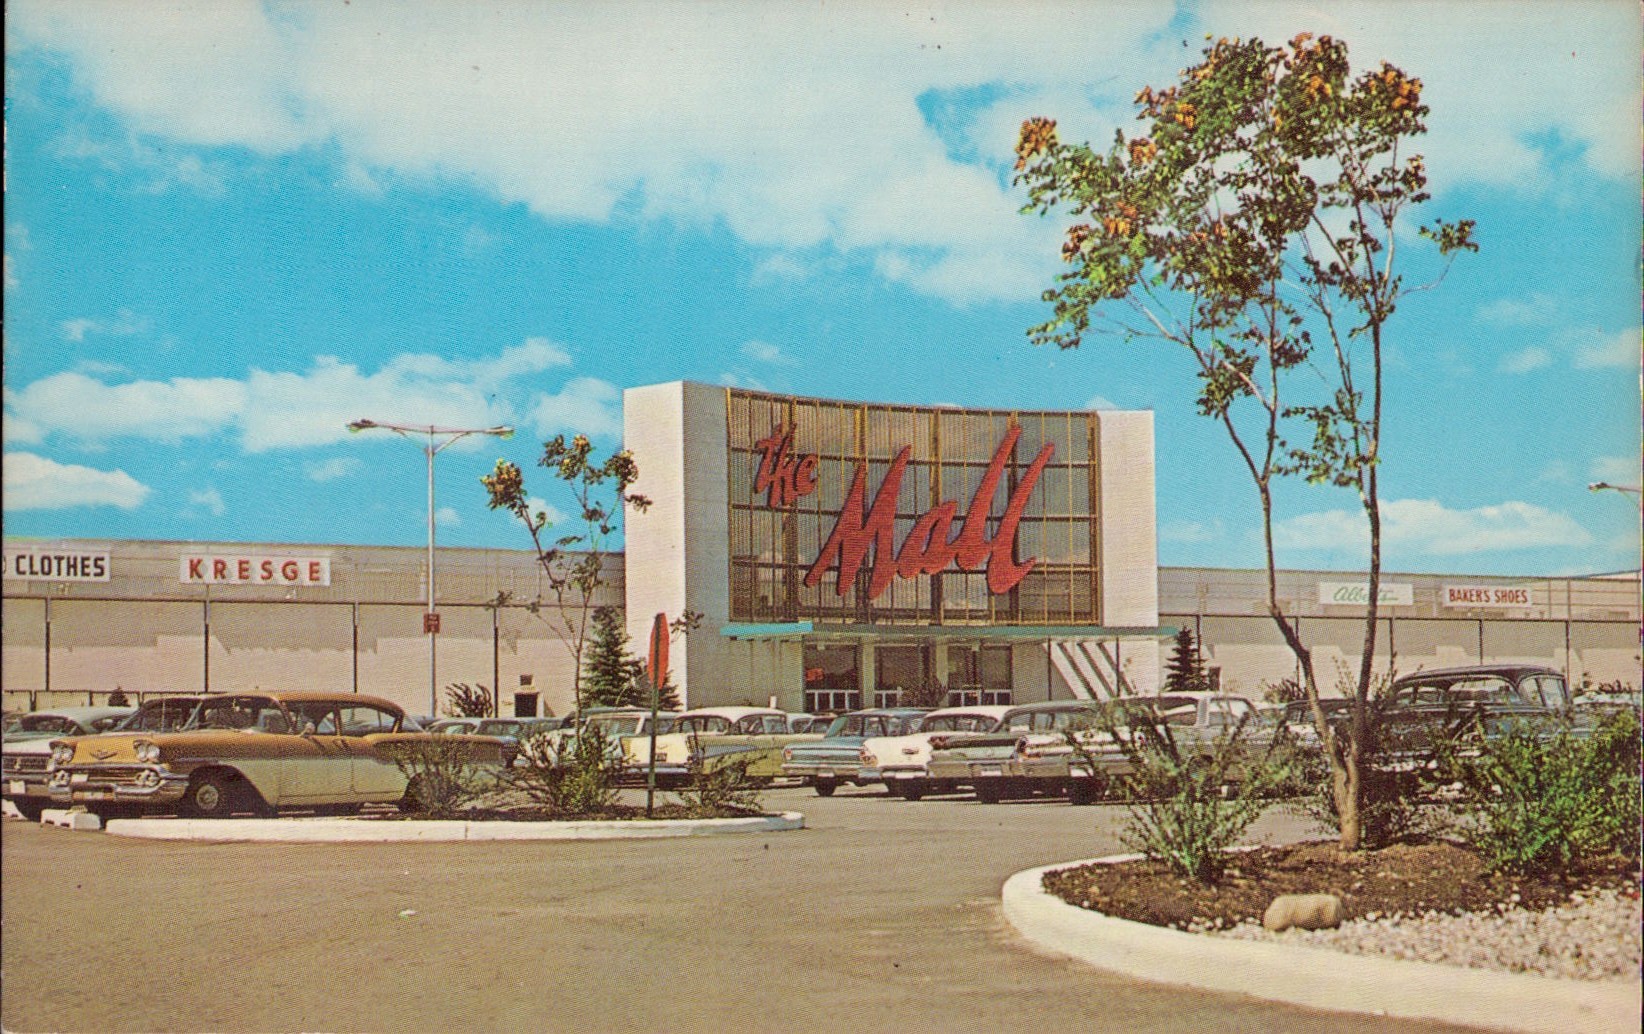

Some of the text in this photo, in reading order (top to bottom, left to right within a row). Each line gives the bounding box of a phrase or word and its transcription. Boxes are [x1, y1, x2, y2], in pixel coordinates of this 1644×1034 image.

[755, 422, 818, 508] the
[804, 425, 1055, 600] Mall
[15, 554, 105, 577] CLOTHES
[189, 558, 321, 581] KRESGE
[1494, 589, 1528, 604] SHOES
